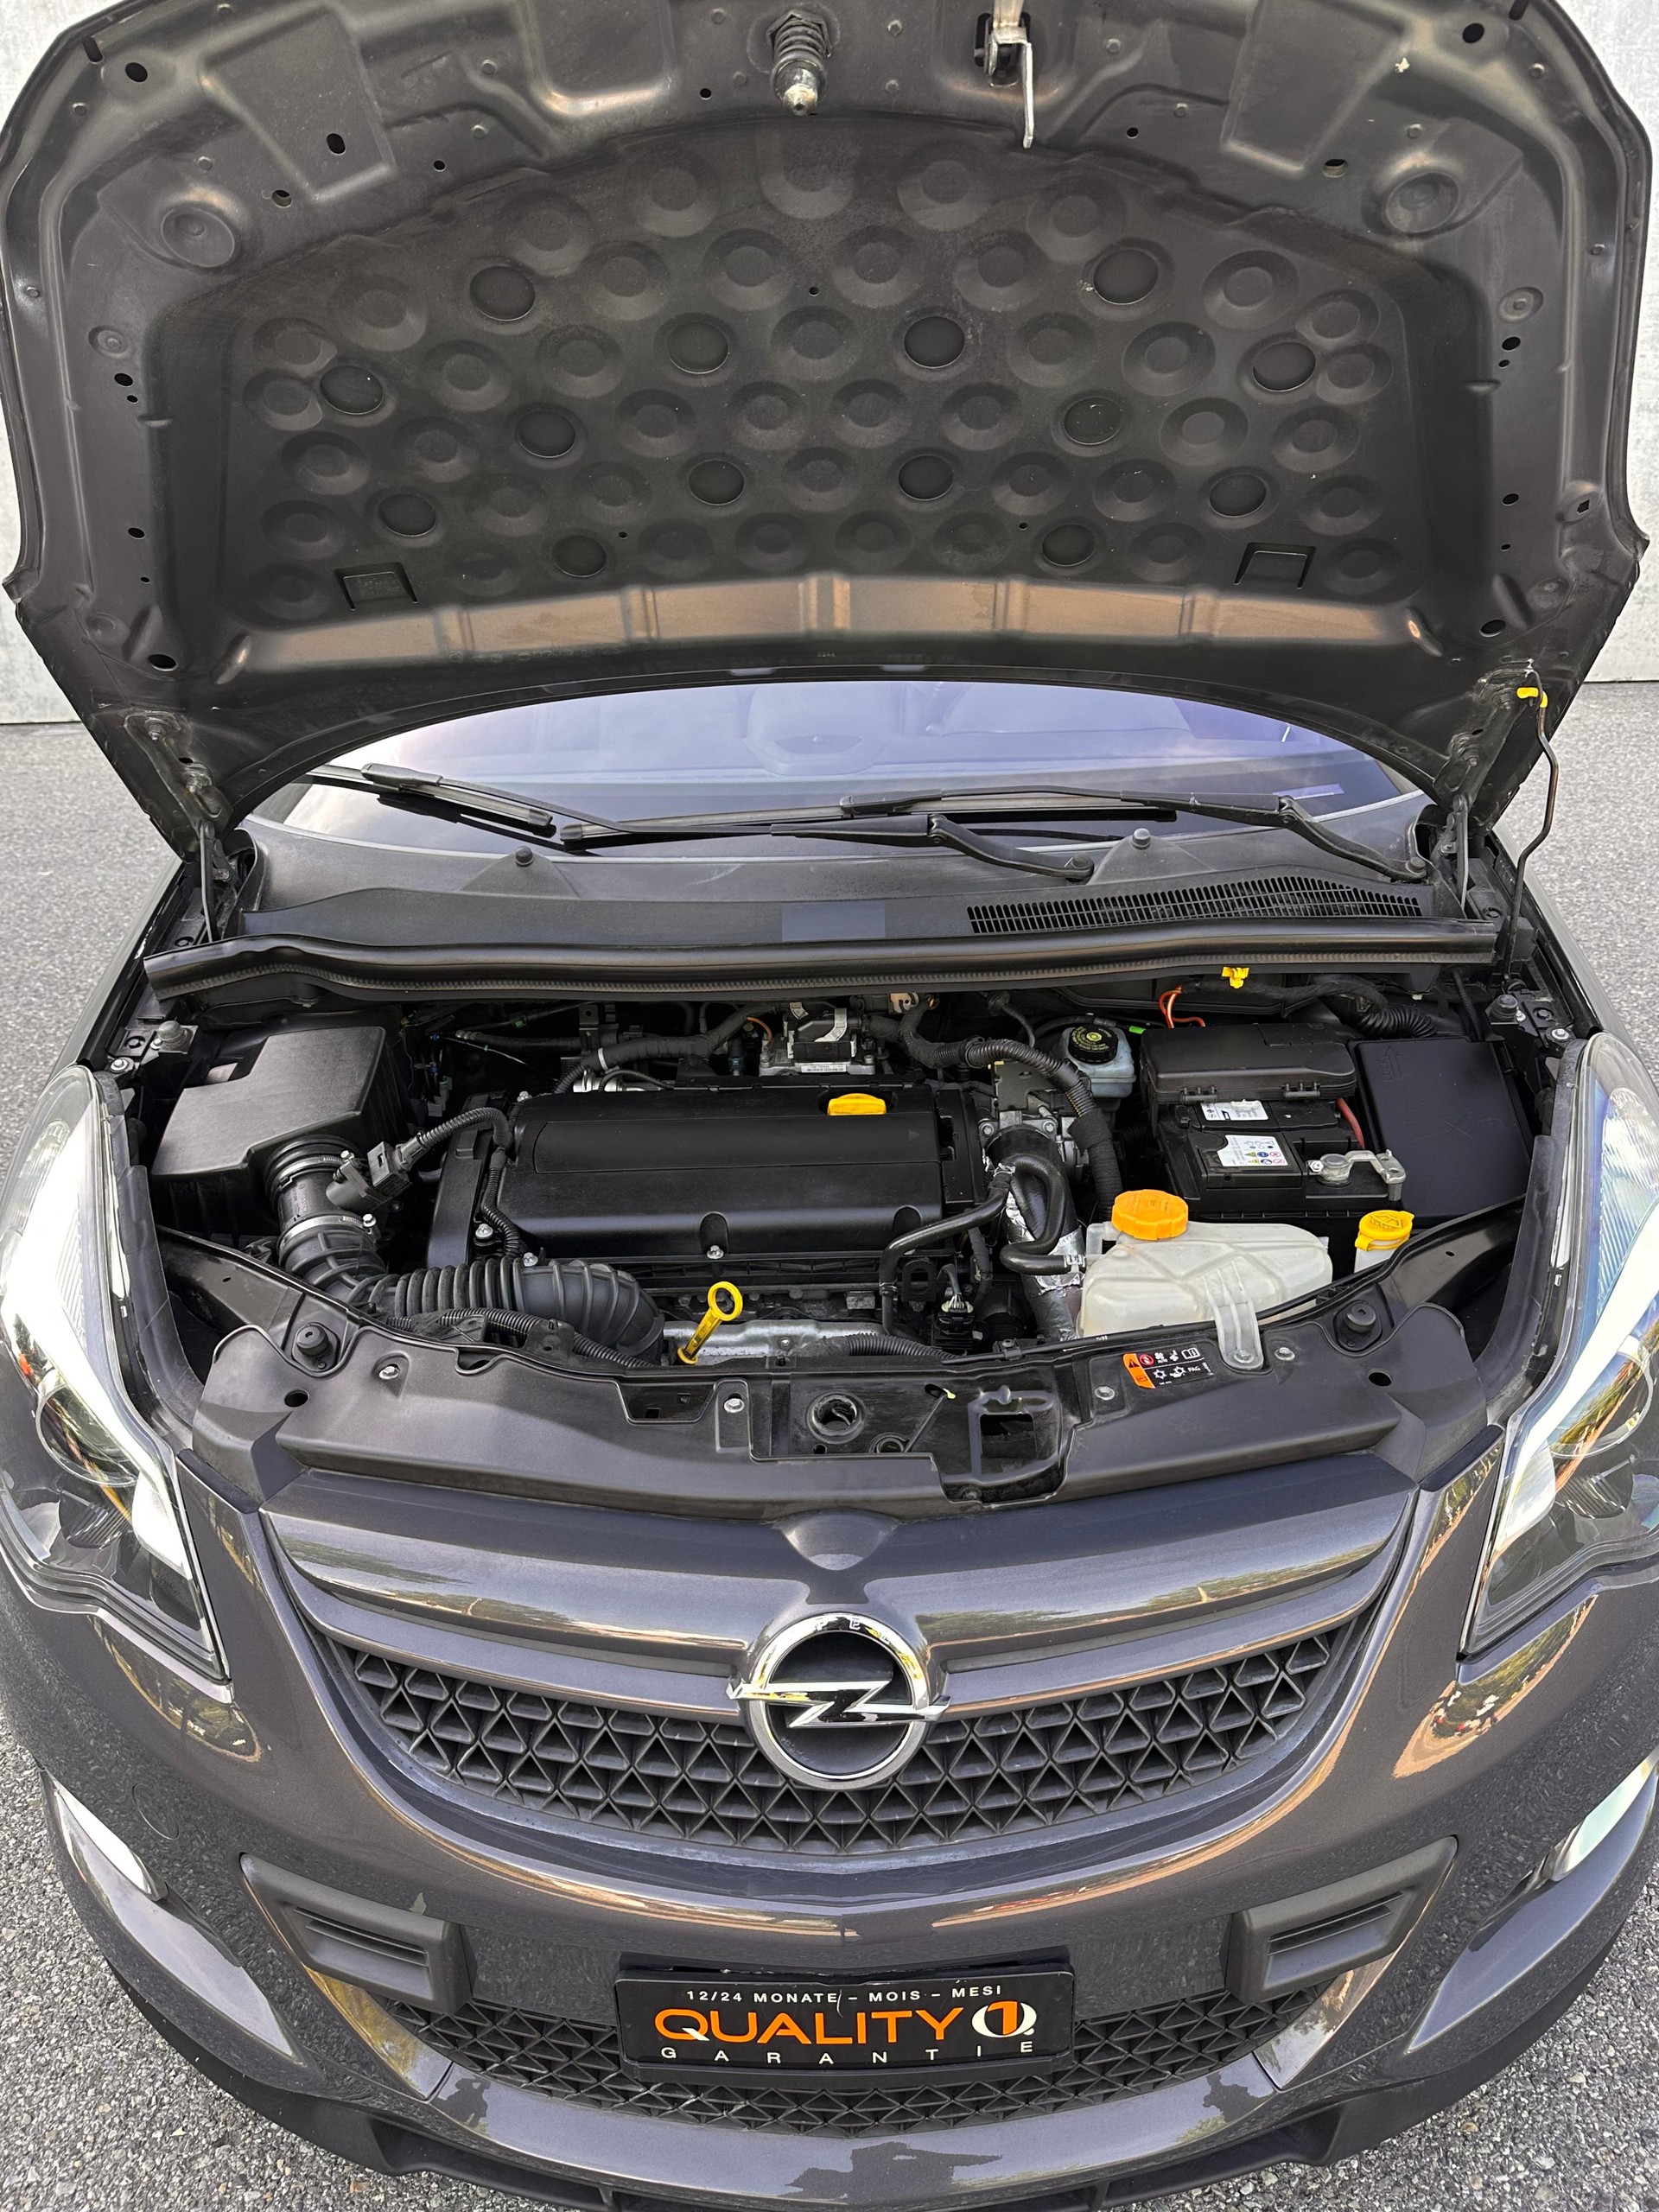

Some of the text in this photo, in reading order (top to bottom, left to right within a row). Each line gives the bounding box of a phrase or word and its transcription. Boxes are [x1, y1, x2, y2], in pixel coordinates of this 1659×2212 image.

[1376, 1058, 1392, 1081] LOCK
[686, 1991, 742, 2002] 12/24
[753, 1993, 837, 2004] MONATE
[868, 1990, 920, 2002] MOIS
[951, 1985, 1001, 1998] MESI
[654, 2006, 964, 2044] QUALITY
[660, 2041, 1033, 2065] GARANTIE
